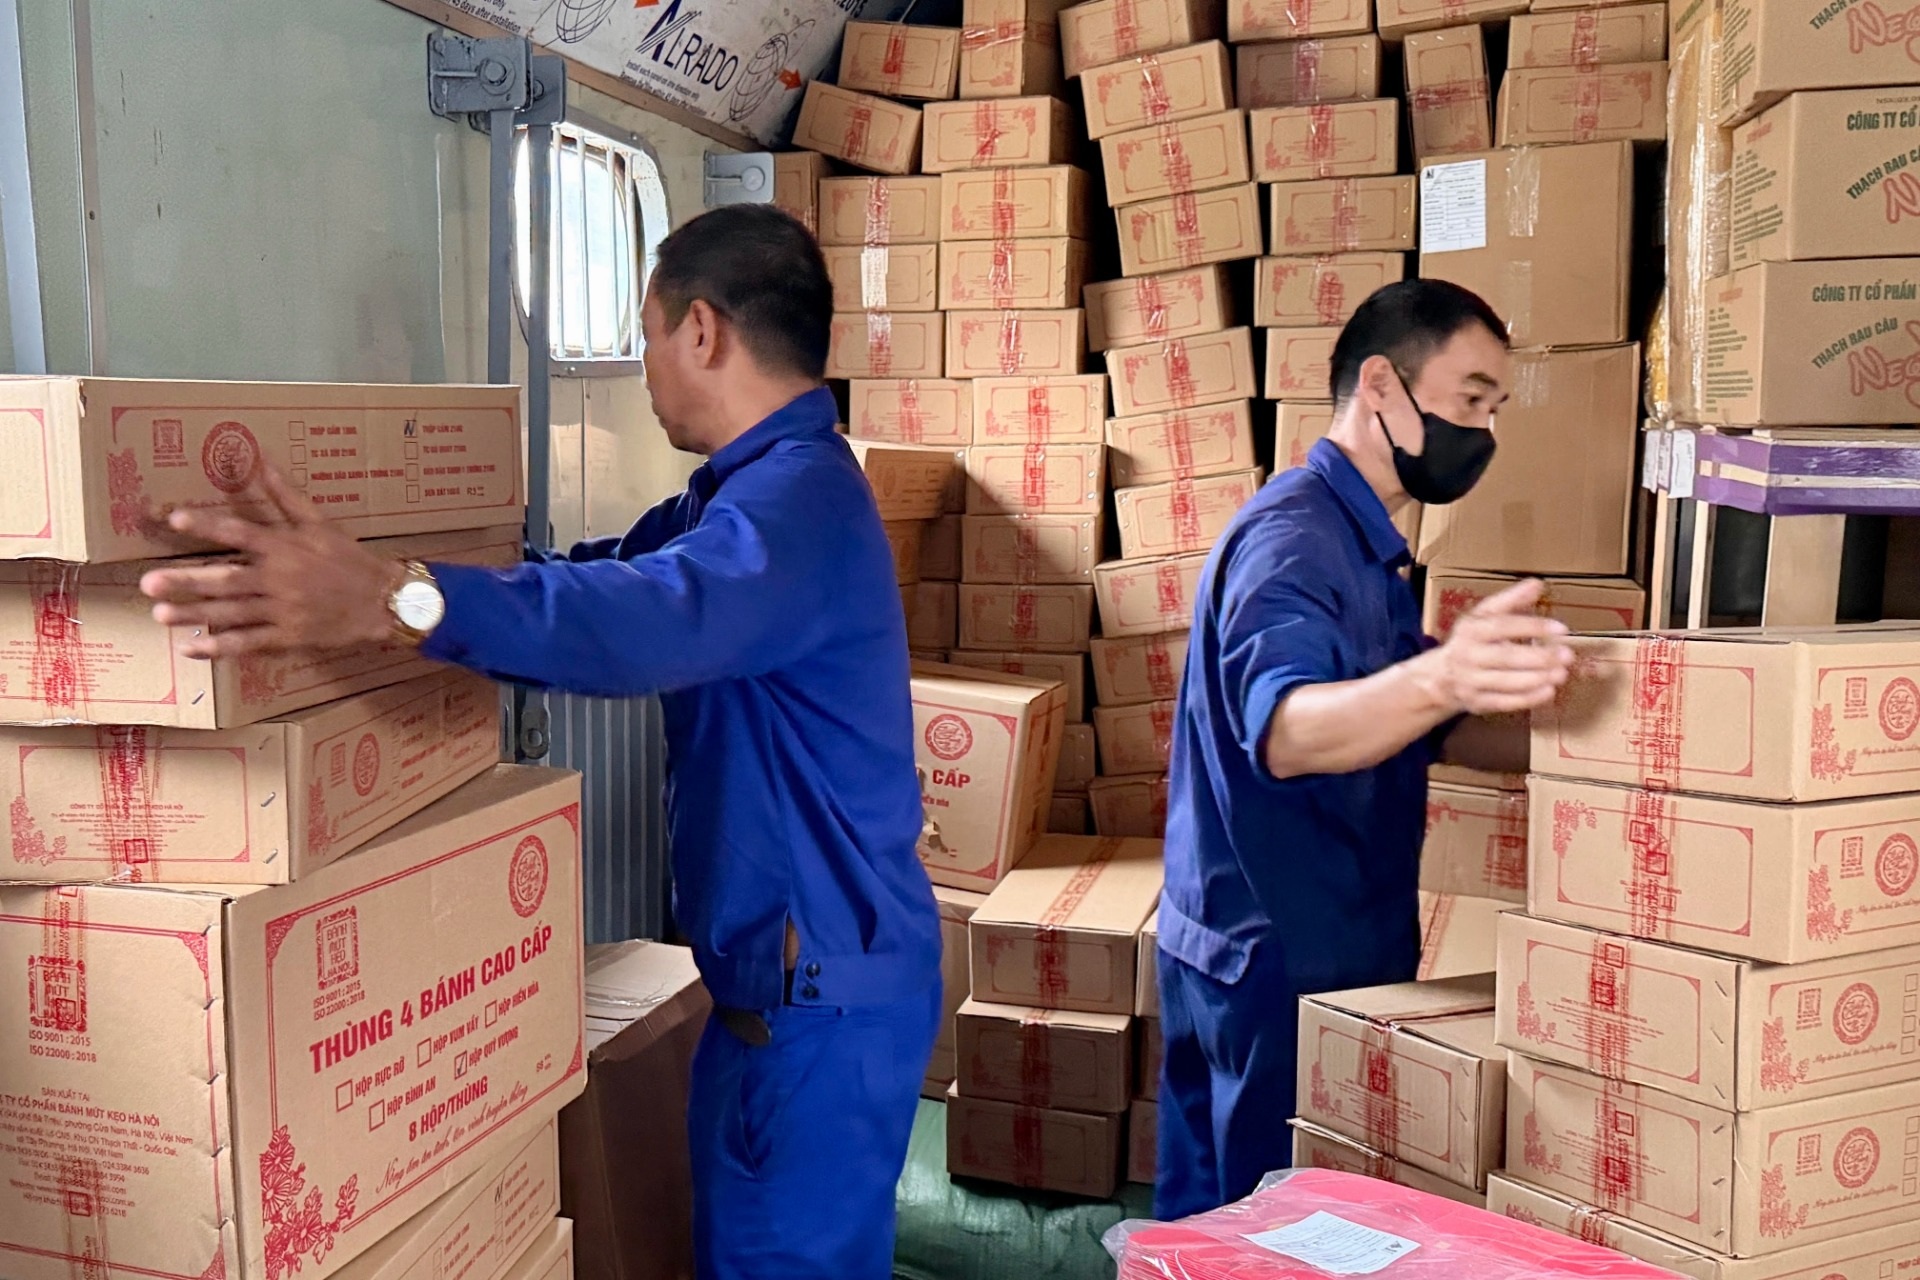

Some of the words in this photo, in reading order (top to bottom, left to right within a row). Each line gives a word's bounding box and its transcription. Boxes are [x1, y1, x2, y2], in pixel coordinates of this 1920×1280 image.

[475, 6, 491, 20] after
[490, 12, 521, 34] installation
[1847, 110, 1880, 131] CÔNG
[1882, 111, 1898, 129] TY
[1846, 166, 1884, 200] THẠCH
[1883, 154, 1908, 175] RAU
[1812, 283, 1845, 302] CÔNG
[1848, 285, 1862, 301] TY
[1865, 279, 1882, 301] CỔ
[1884, 278, 1917, 300] PHẦN
[1811, 338, 1849, 370] THẠCH
[1848, 326, 1873, 346] RAU
[1874, 317, 1898, 335] CÂU
[932, 767, 972, 789] CẤP
[309, 1020, 394, 1075] THÙNG
[400, 999, 415, 1029] 4
[419, 964, 476, 1020] BÁNH
[481, 946, 516, 986] CAO
[521, 920, 553, 963] CẤP
[313, 997, 325, 1010] ISO
[326, 990, 342, 1004] 9001
[346, 980, 361, 996] 2015
[314, 1009, 326, 1022] ISO
[326, 1000, 346, 1016] 22000
[350, 990, 366, 1006] 2018
[29, 1029, 44, 1040] ISO
[44, 1030, 65, 1044] 9001
[70, 1034, 92, 1048] 2015
[433, 1034, 448, 1055] HỘP
[29, 1044, 44, 1057] ISO
[45, 1046, 71, 1060] 22000
[76, 1050, 97, 1063] 2018
[469, 1047, 482, 1067] HỘP
[355, 1075, 373, 1098] HỘP
[375, 1065, 391, 1087] RỰC
[393, 1055, 405, 1077] RỠ
[387, 1095, 403, 1117] HỘP
[405, 1082, 424, 1106] BÌNH
[425, 1075, 436, 1095] AN
[408, 1122, 418, 1143] 8
[420, 1075, 490, 1134] HỘP/THÙNG
[4, 1094, 16, 1105] TY
[18, 1094, 30, 1108] CỔ
[32, 1098, 57, 1112] PHẦN
[59, 1102, 84, 1116] BÁNH
[86, 1106, 105, 1119] MỨT
[107, 1110, 126, 1124] KẸO
[128, 1111, 142, 1124] HÀ
[144, 1113, 160, 1129] NỘI
[65, 1119, 93, 1132] phường
[175, 1135, 194, 1145] Nam
